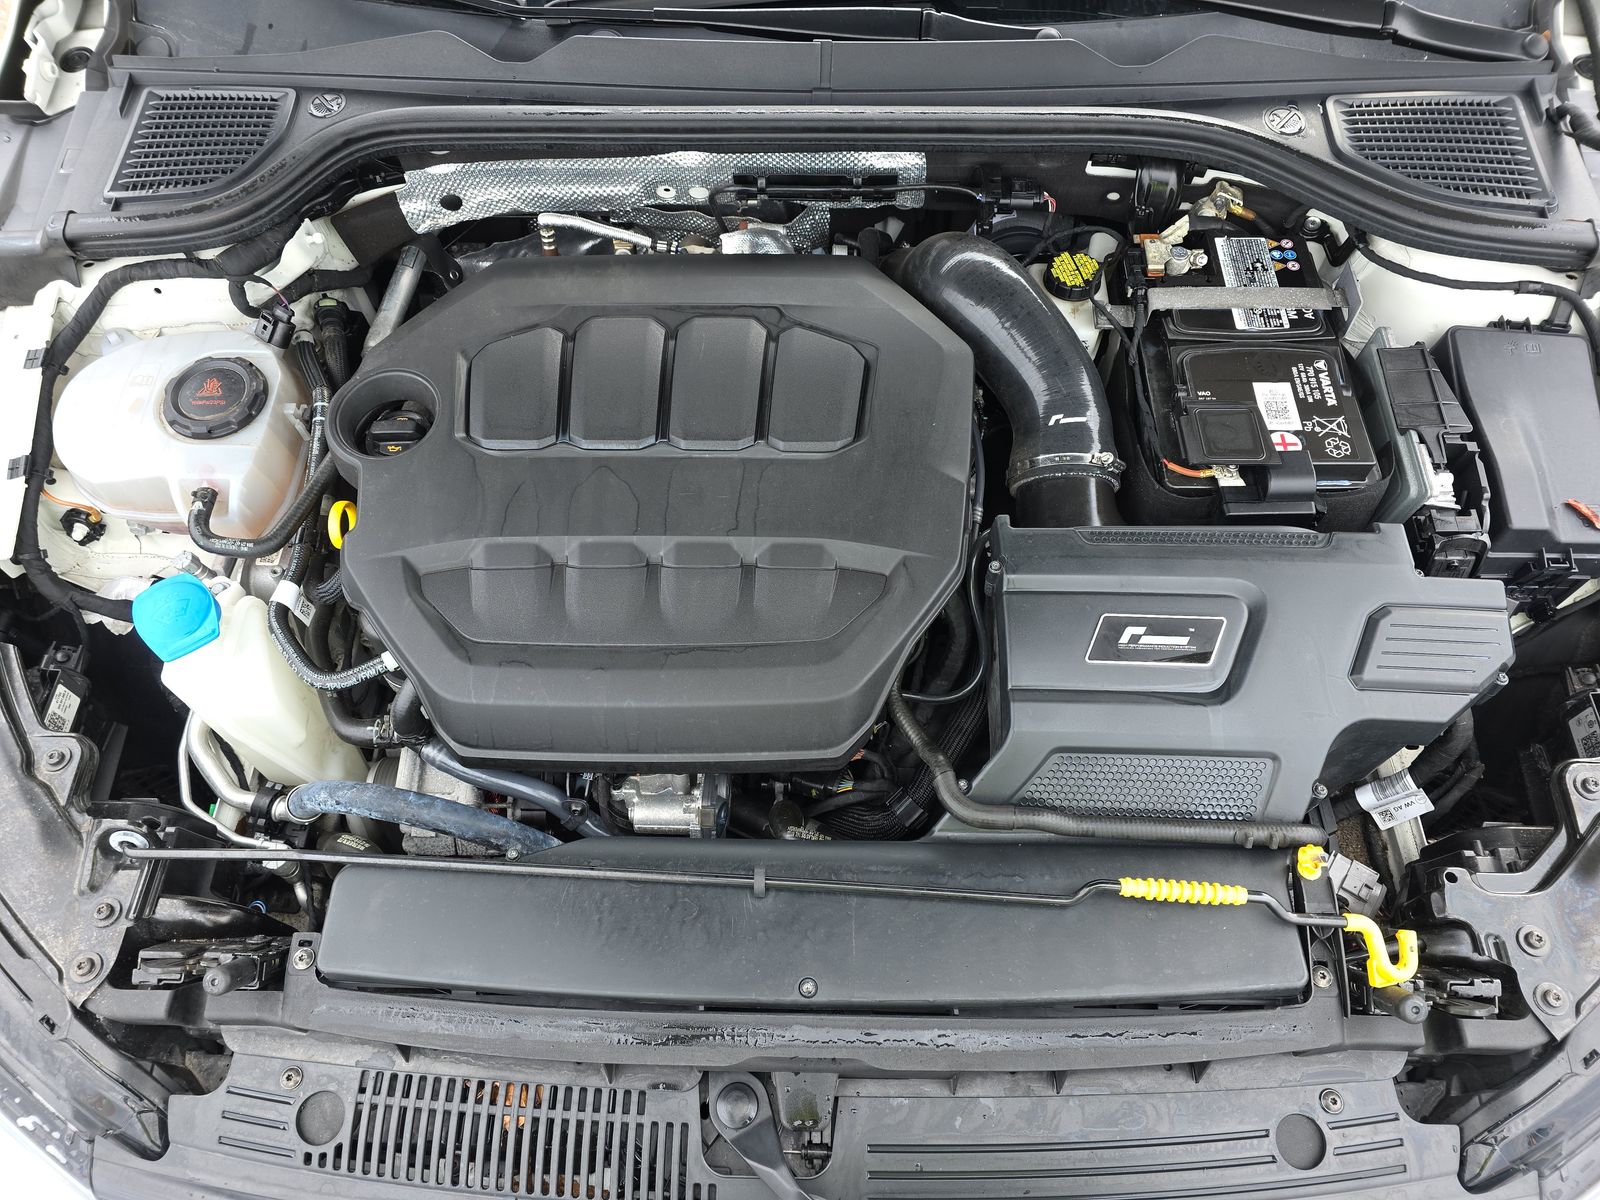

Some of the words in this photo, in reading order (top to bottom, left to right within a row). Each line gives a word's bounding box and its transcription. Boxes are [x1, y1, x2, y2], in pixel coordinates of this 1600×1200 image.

[1309, 378, 1318, 388] 915
[1318, 371, 1338, 407] VARTA
[1302, 421, 1313, 432] Pb
[1404, 800, 1416, 808] VW
